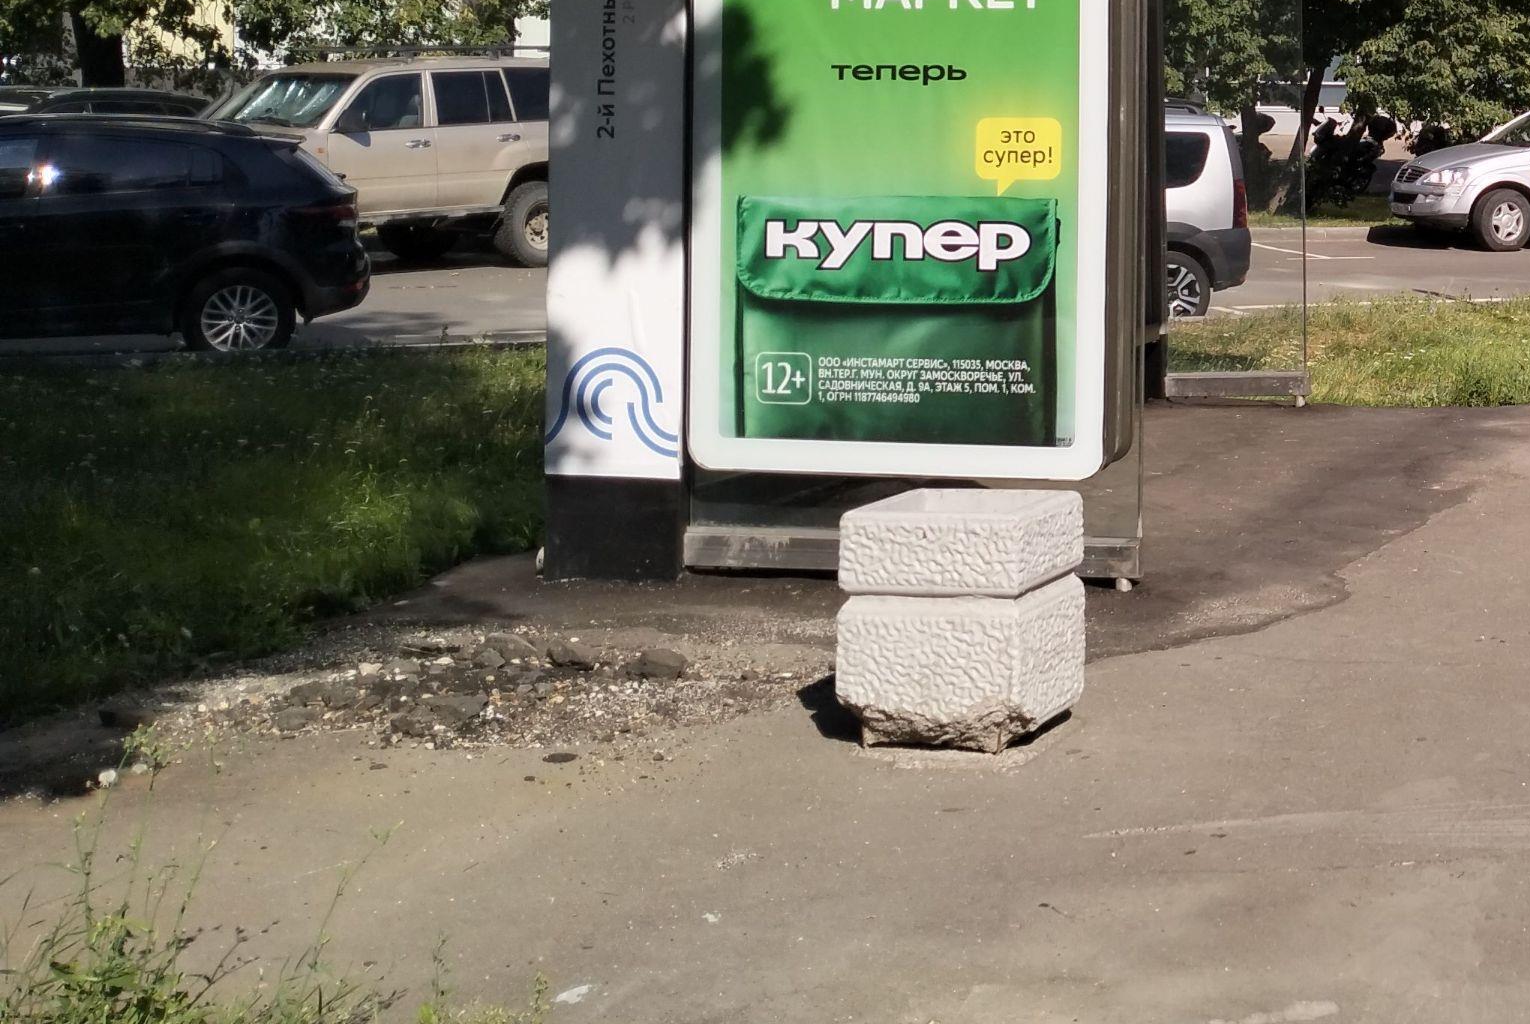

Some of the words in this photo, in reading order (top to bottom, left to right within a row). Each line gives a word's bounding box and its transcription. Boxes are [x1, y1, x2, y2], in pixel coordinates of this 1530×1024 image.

[831, 63, 967, 86] теперь
[597, 104, 615, 139] 2-й
[1000, 129, 1036, 144] это
[983, 146, 1054, 168] супер!
[765, 219, 1032, 271] купер
[819, 357, 840, 367] ООО
[953, 360, 984, 371] 115035,
[986, 360, 1030, 372] МОСКВА,
[761, 362, 806, 394] 12+
[861, 370, 884, 379] МУН.
[887, 370, 919, 380] ОКРУГ
[920, 371, 1006, 382] ЗАМОСКВОРЕЧЬЕ,
[1008, 372, 1024, 382] УЛ.
[819, 380, 904, 392] САДОВНИЧЕСКАЯ,
[906, 382, 916, 392] Д.
[935, 382, 962, 392] ЭТАЖ
[974, 383, 1000, 393] ПОМ.
[1011, 384, 1036, 394] КОМ.
[827, 392, 852, 402] ОГРН
